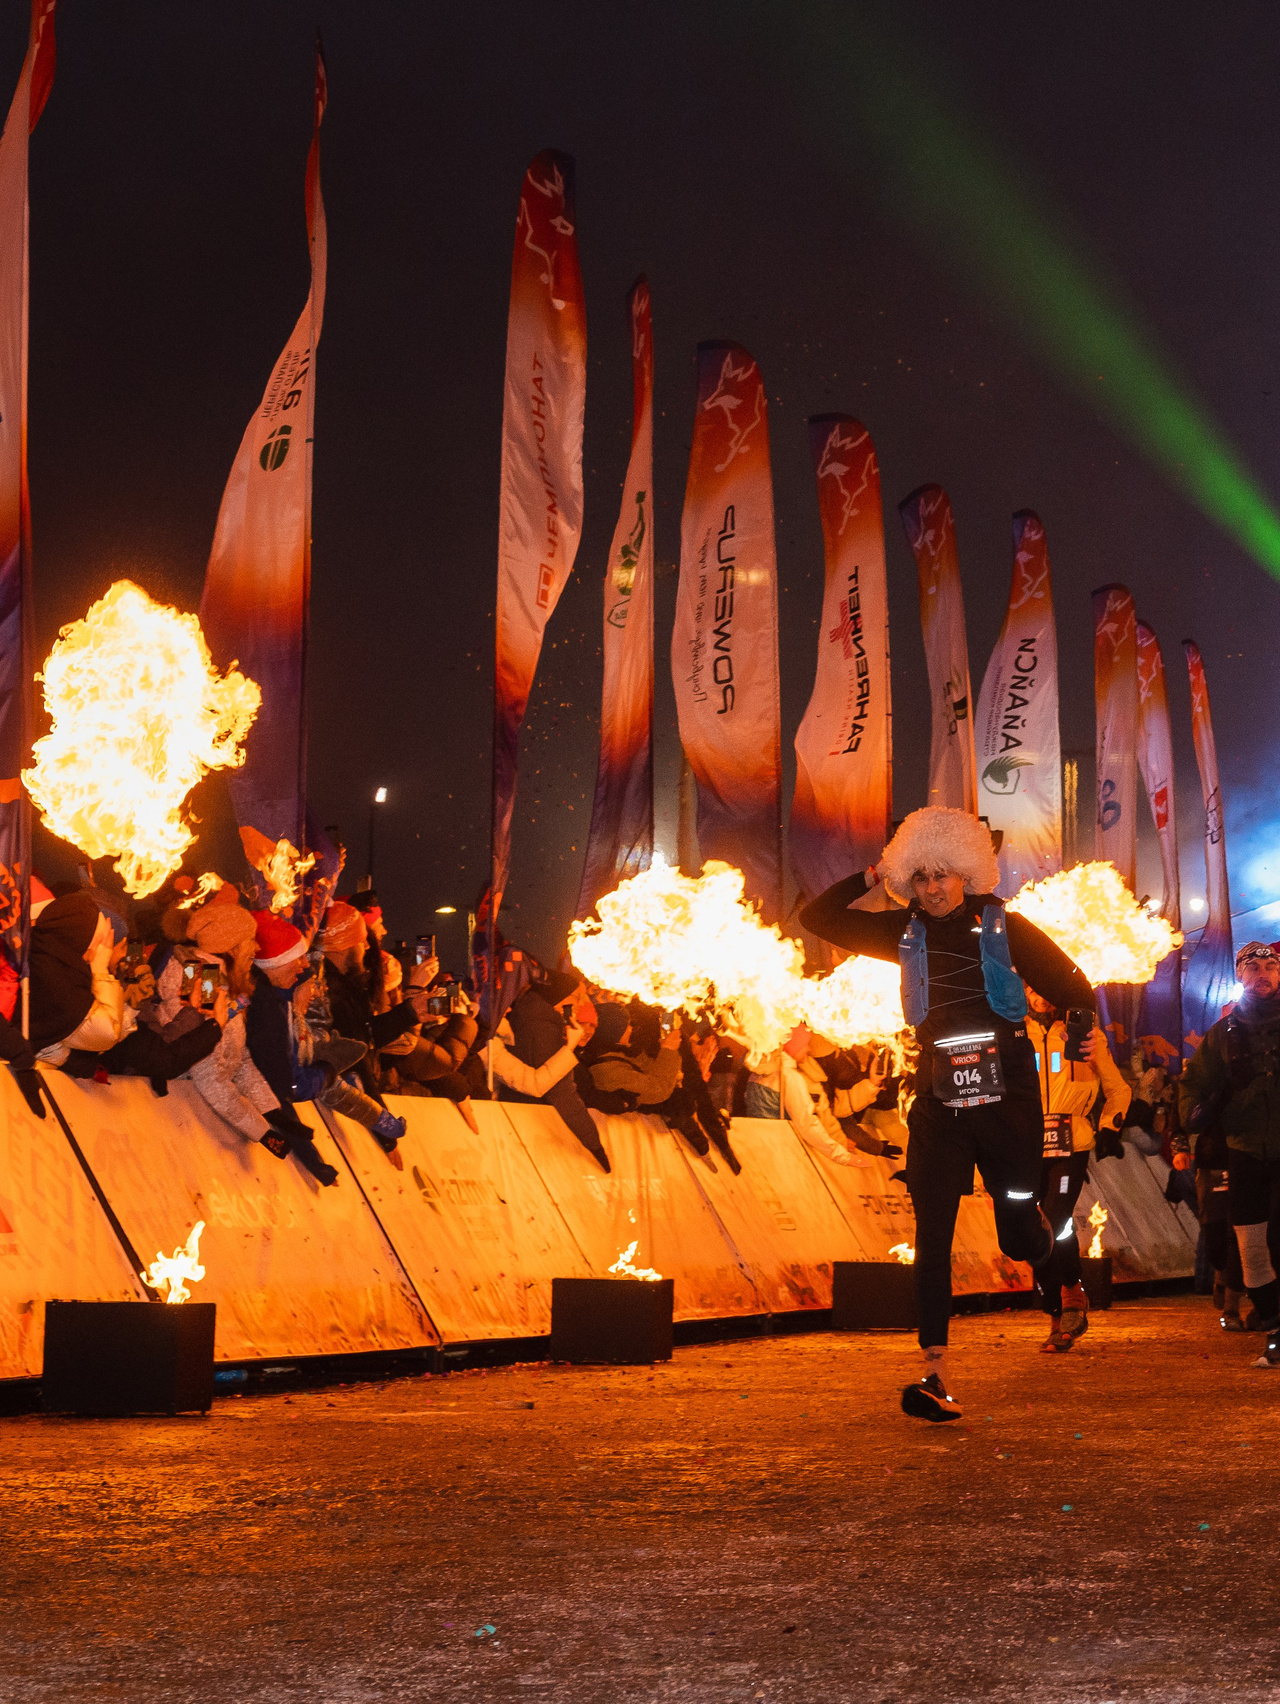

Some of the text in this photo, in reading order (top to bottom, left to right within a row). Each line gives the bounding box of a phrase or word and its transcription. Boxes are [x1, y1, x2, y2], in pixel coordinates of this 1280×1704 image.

[531, 352, 559, 559] ЧЕМПИОНАТ
[953, 1054, 978, 1064] VR100
[953, 1068, 982, 1086] 014
[958, 1087, 980, 1095] ИГОРЬ
